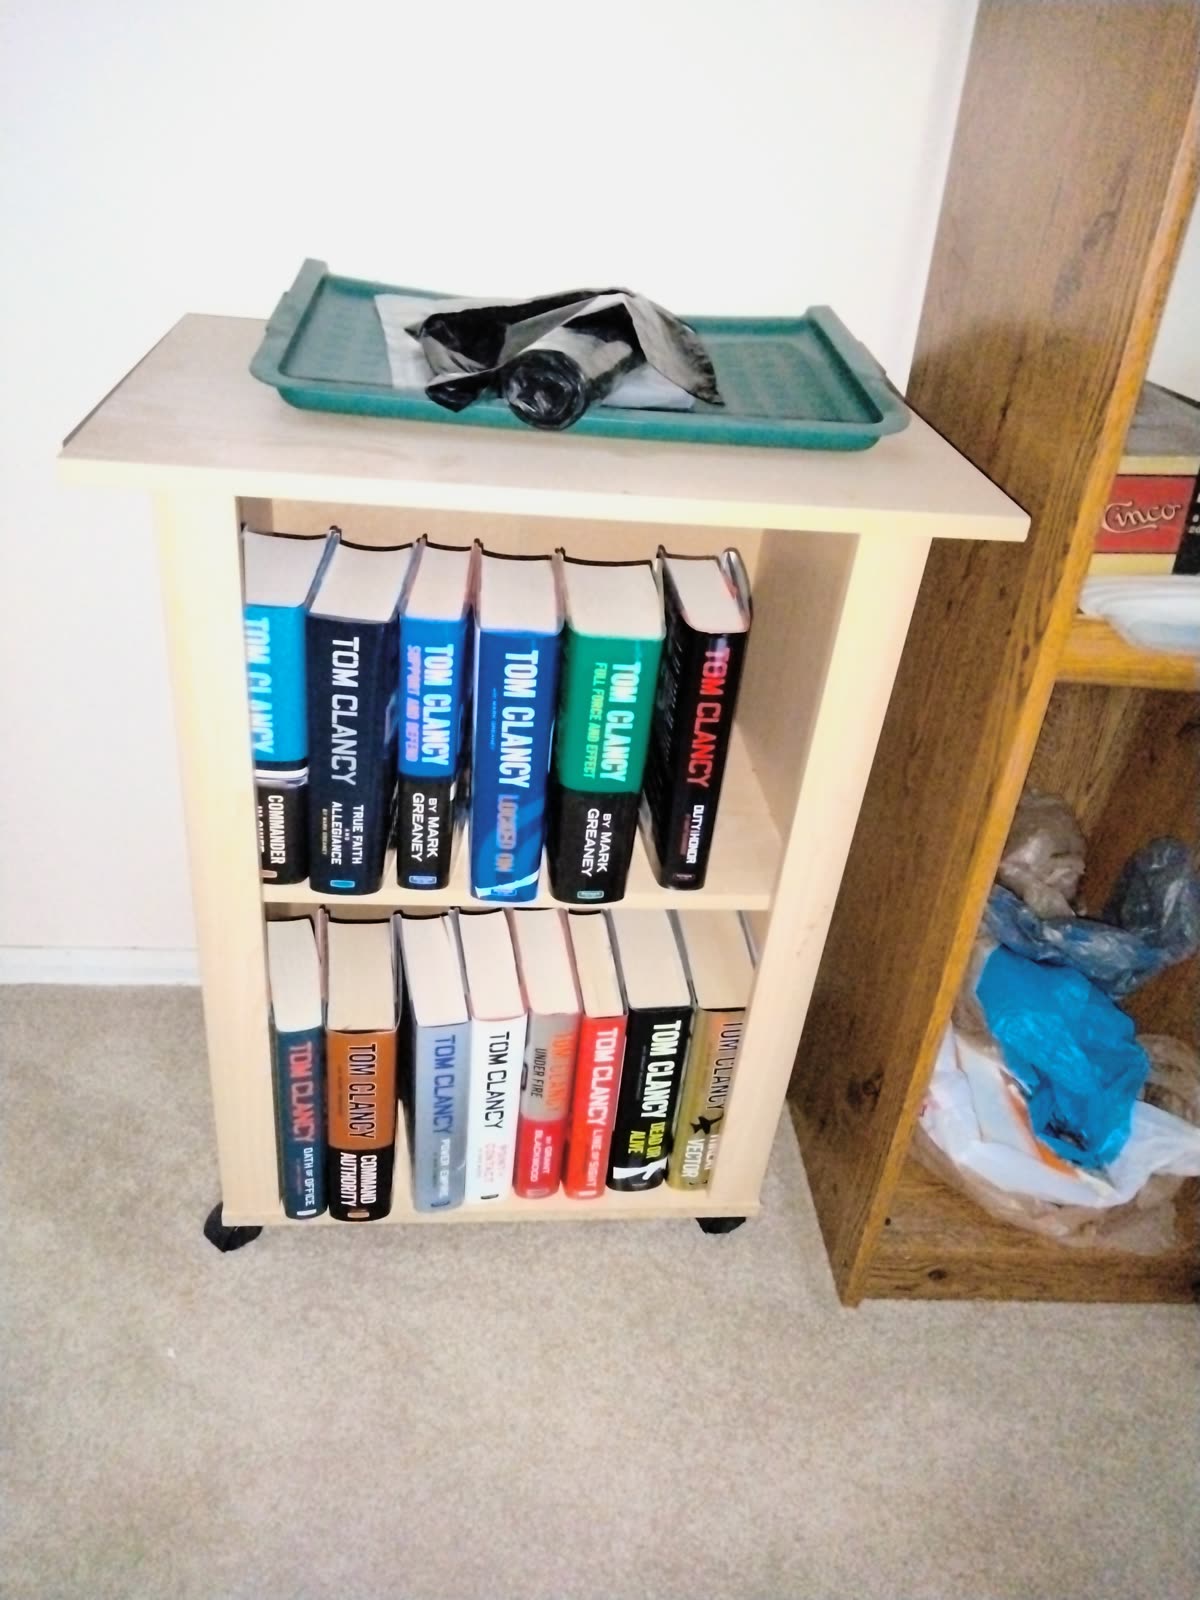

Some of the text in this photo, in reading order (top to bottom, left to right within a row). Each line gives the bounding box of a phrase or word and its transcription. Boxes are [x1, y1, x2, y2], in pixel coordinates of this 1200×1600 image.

[331, 637, 359, 785] TOM CLANCY
[421, 644, 454, 766] TOM CLANCY
[498, 650, 538, 788] TOM CLANCY
[584, 662, 607, 779] FULL FORCE AND EFFECT
[600, 662, 641, 782] TOM CLANCY
[686, 647, 730, 788] TOM CLANCY
[268, 795, 285, 864] COMMANDER
[331, 801, 343, 865] ALLEGIANCE
[352, 805, 364, 864] TRUE FAITH
[410, 792, 425, 862] GREANEY
[427, 798, 440, 858] BY MARK
[580, 808, 600, 877] GREANEY
[596, 813, 612, 872] BY MARK
[691, 805, 704, 830] DUTY
[686, 834, 699, 864] HONOR
[289, 1042, 315, 1142] TOM CLANCY
[348, 1043, 377, 1140] TOM CLANCY
[432, 1034, 455, 1134] TOM CLANCY
[484, 1031, 510, 1129] TOM CLANCY
[531, 1048, 547, 1099] UNDER FIRE
[587, 1027, 618, 1126] TOM CLANCY
[640, 1020, 682, 1118] TOM CLANCY
[530, 1129, 544, 1183] BLACKWOOD
[542, 1146, 552, 1174] GRANT
[592, 1129, 603, 1151] LINE
[628, 1130, 646, 1154] ALIVE
[646, 1121, 666, 1159] DEAD OR
[681, 1138, 704, 1178] VECTOR
[304, 1147, 314, 1206] OATH OF OFFICE
[340, 1152, 357, 1207] AUTHORITY
[360, 1155, 377, 1205] COMMAND
[586, 1160, 599, 1186] SIGHT
